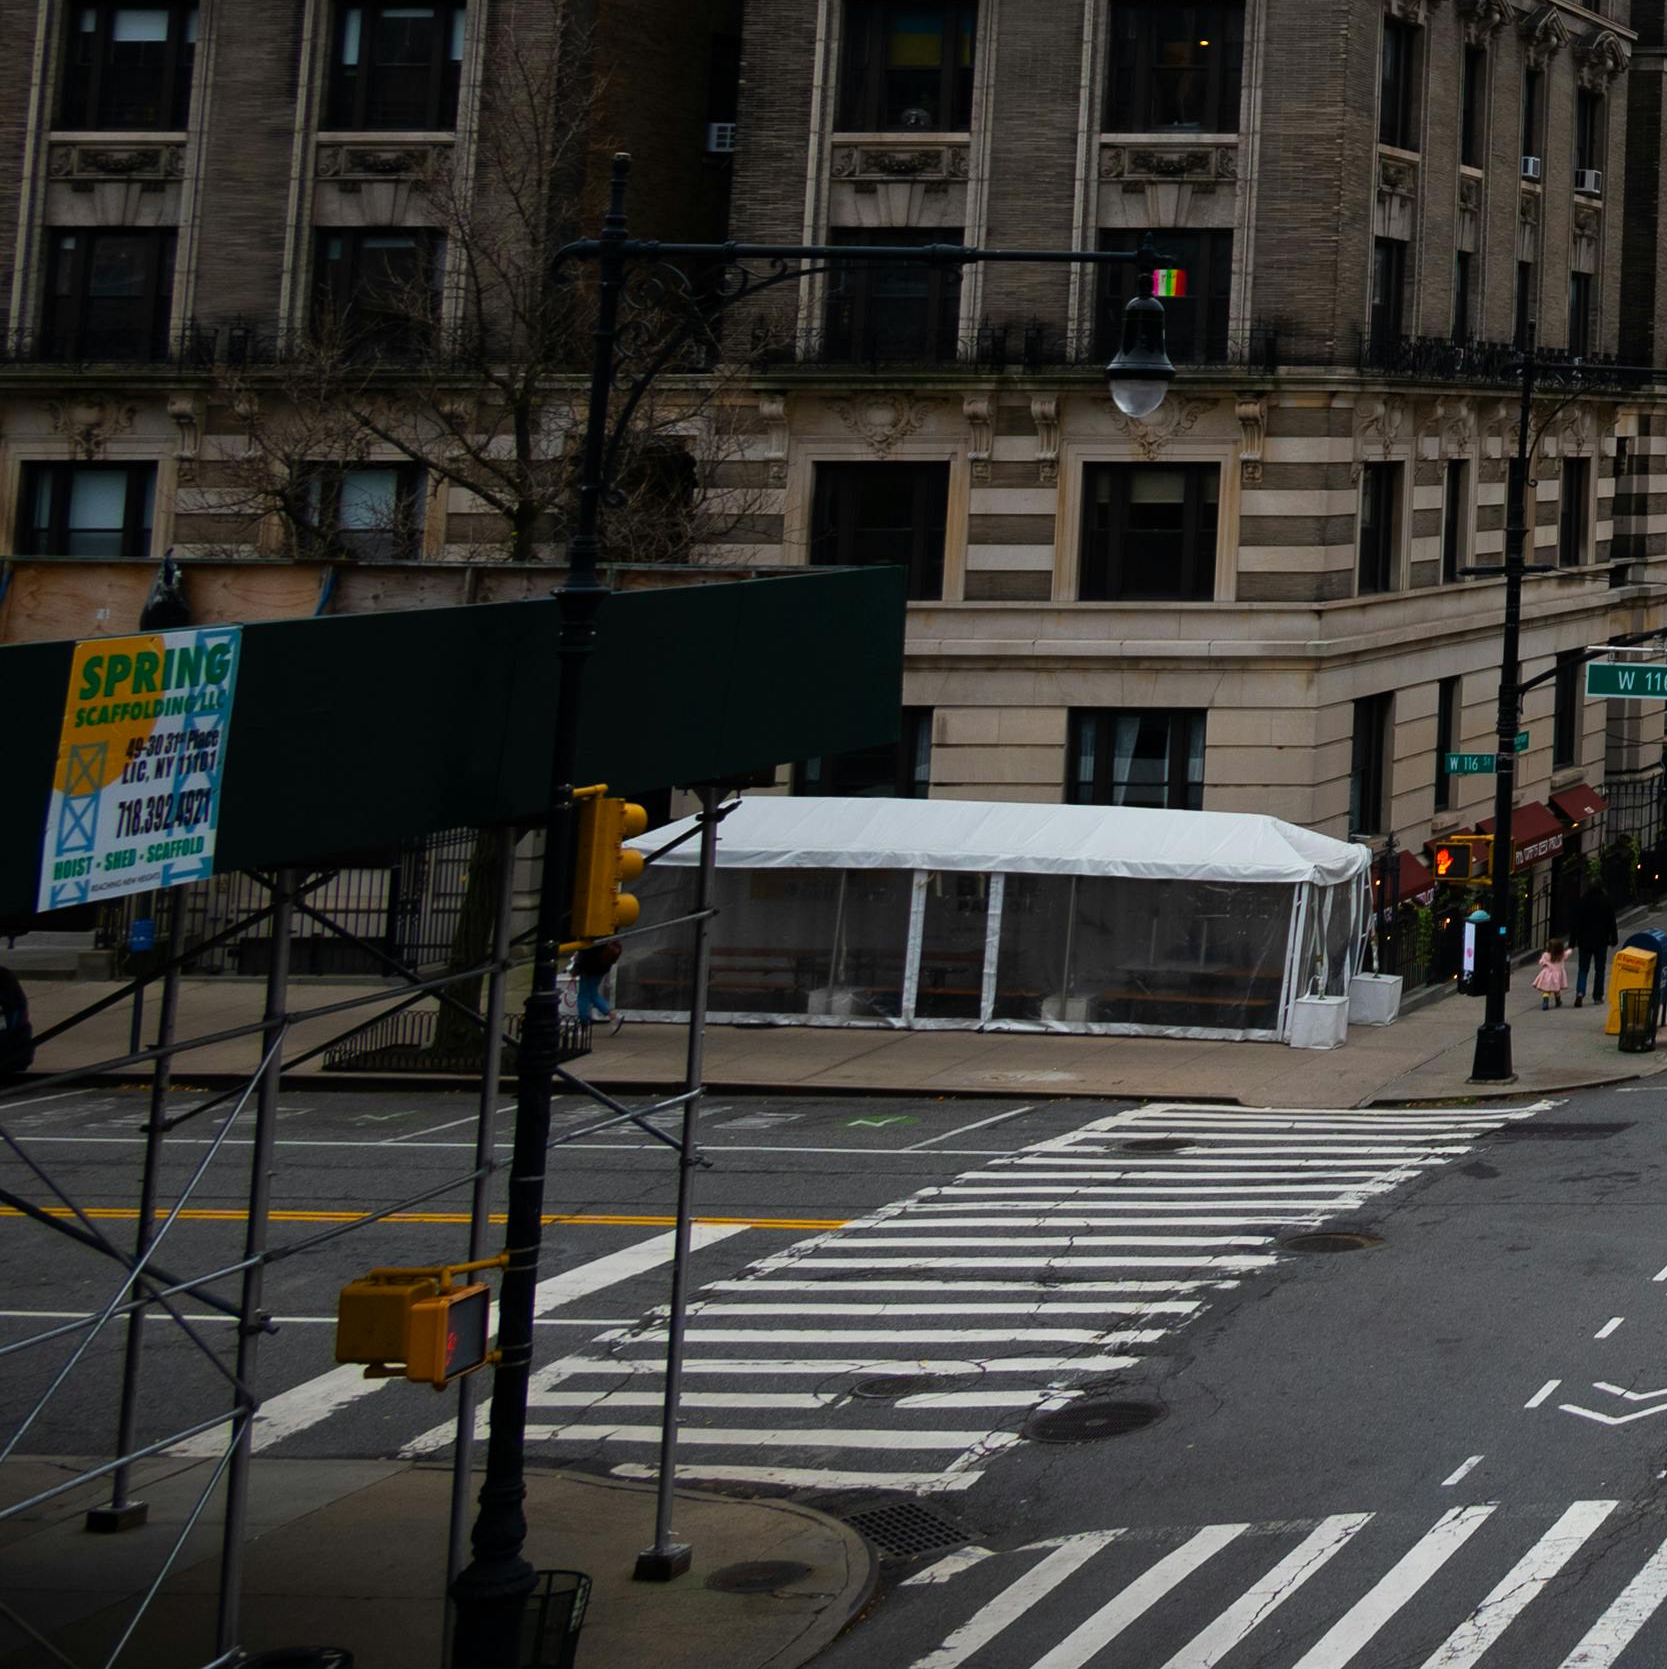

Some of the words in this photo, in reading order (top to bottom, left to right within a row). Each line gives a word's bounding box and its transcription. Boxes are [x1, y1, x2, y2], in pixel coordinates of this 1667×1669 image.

[78, 643, 231, 701] SPRING
[1618, 671, 1635, 691] W
[74, 695, 194, 728] SCAFFOLDING
[199, 689, 226, 712] LLC
[125, 735, 162, 759] 49-30
[186, 729, 220, 751] Place
[121, 760, 151, 786] LIC,
[153, 758, 176, 781] NY
[176, 750, 217, 777] 11101
[1449, 757, 1458, 771] W
[1463, 757, 1479, 771] 116
[1483, 757, 1492, 766] St
[52, 856, 94, 881] HOIST
[104, 848, 137, 872] SHED
[146, 836, 205, 863] SCAFFOLD
